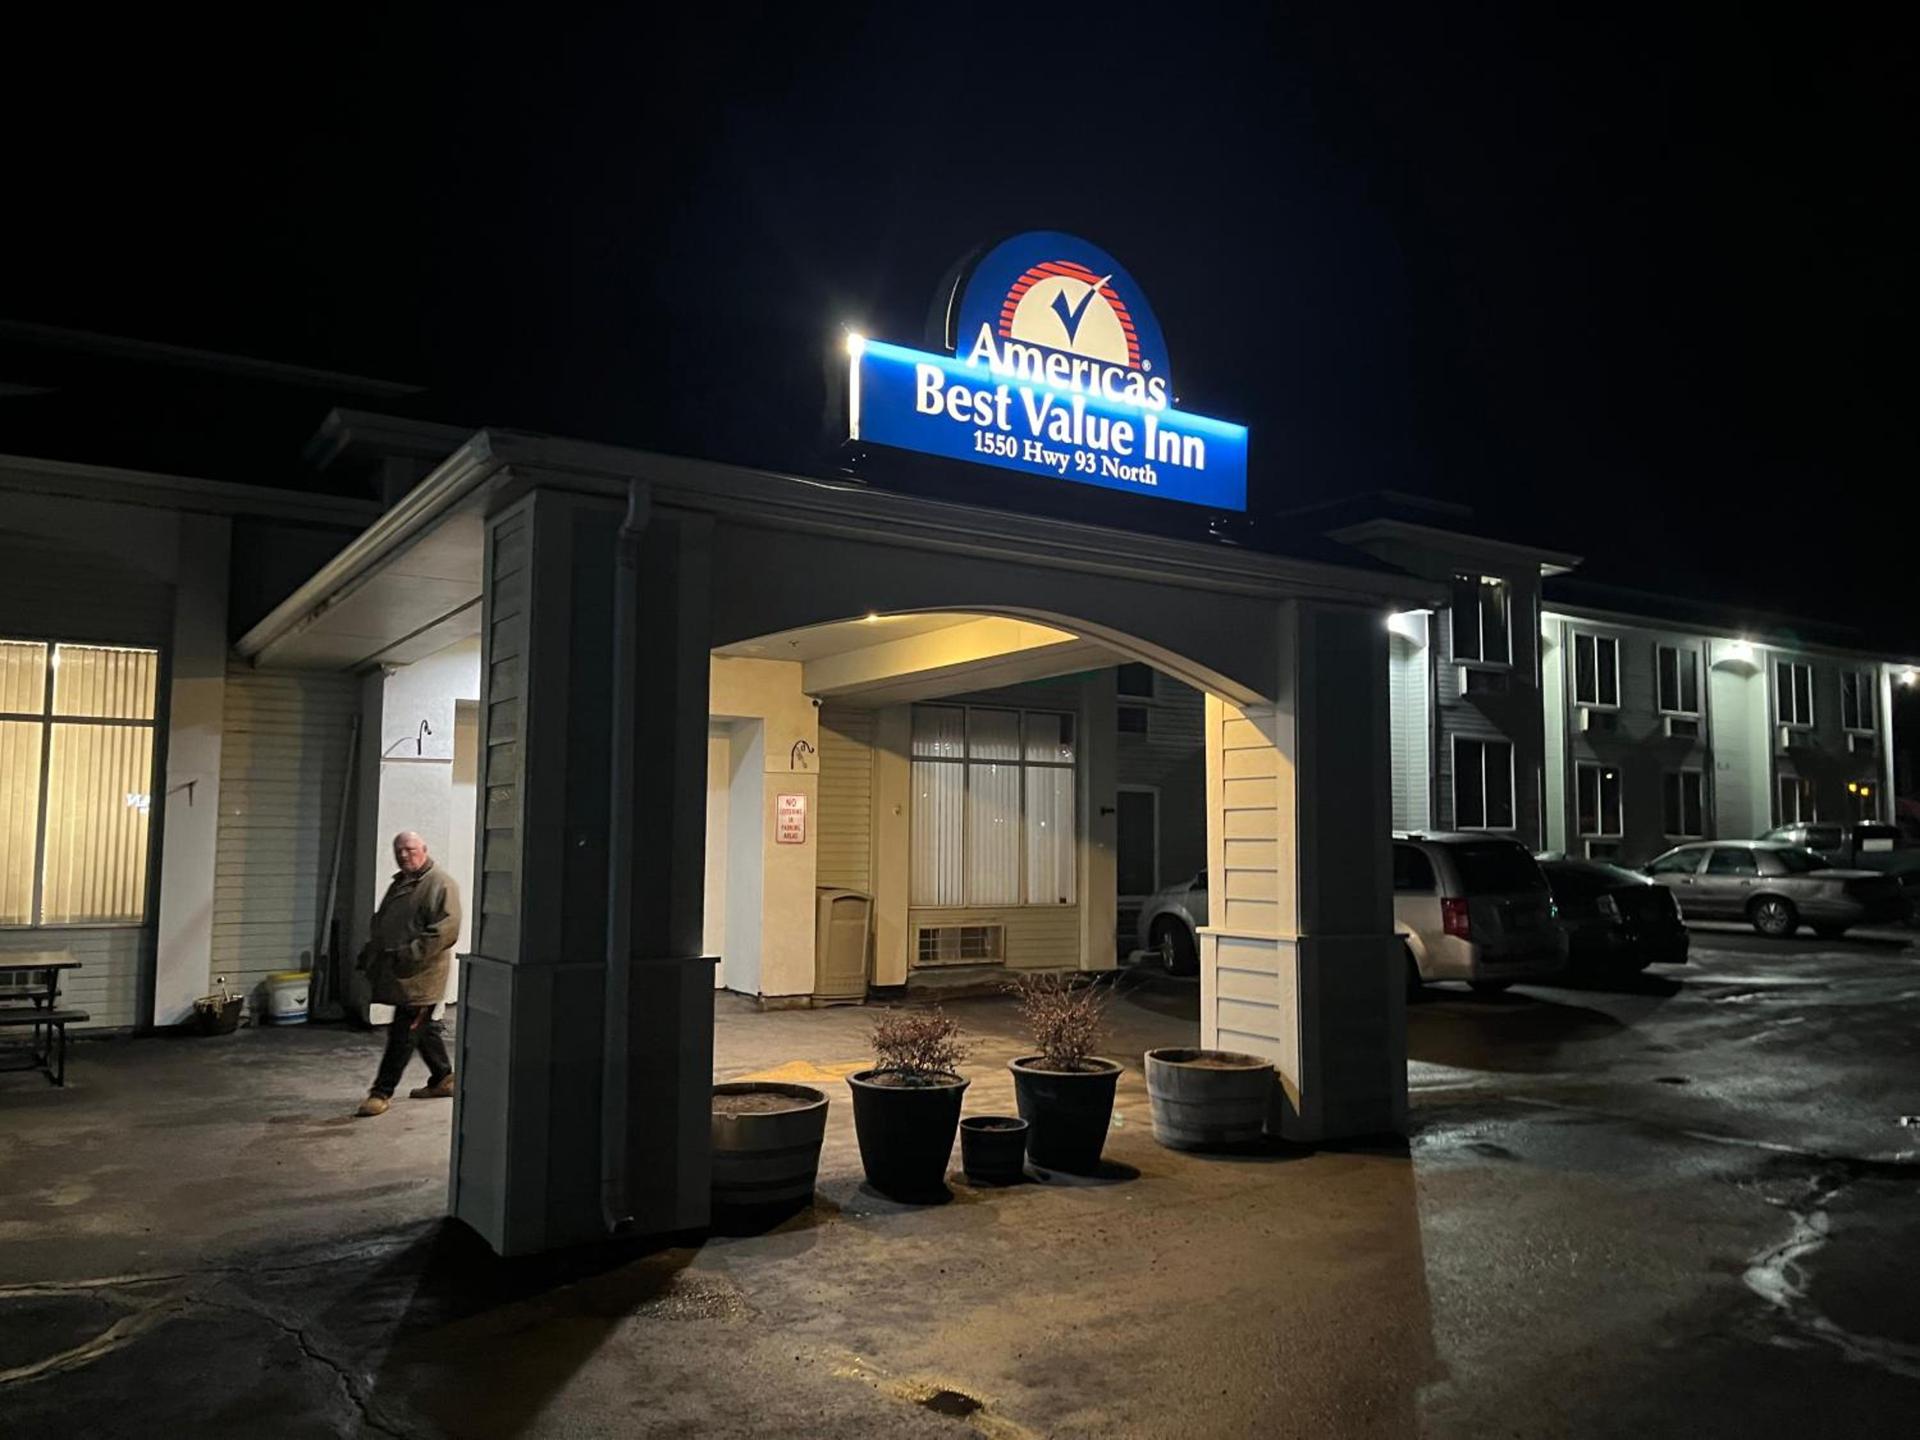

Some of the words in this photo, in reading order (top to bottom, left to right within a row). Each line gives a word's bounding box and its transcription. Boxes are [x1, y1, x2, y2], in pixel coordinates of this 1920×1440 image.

[966, 322, 1166, 412] Americas
[916, 363, 1013, 431] Best
[1019, 387, 1133, 455] Value
[1144, 413, 1205, 470] Inn
[974, 431, 1018, 463] 1550
[1022, 440, 1070, 474] Hwy
[1075, 451, 1097, 474] 93
[1101, 455, 1158, 487] North
[785, 798, 797, 807] NO
